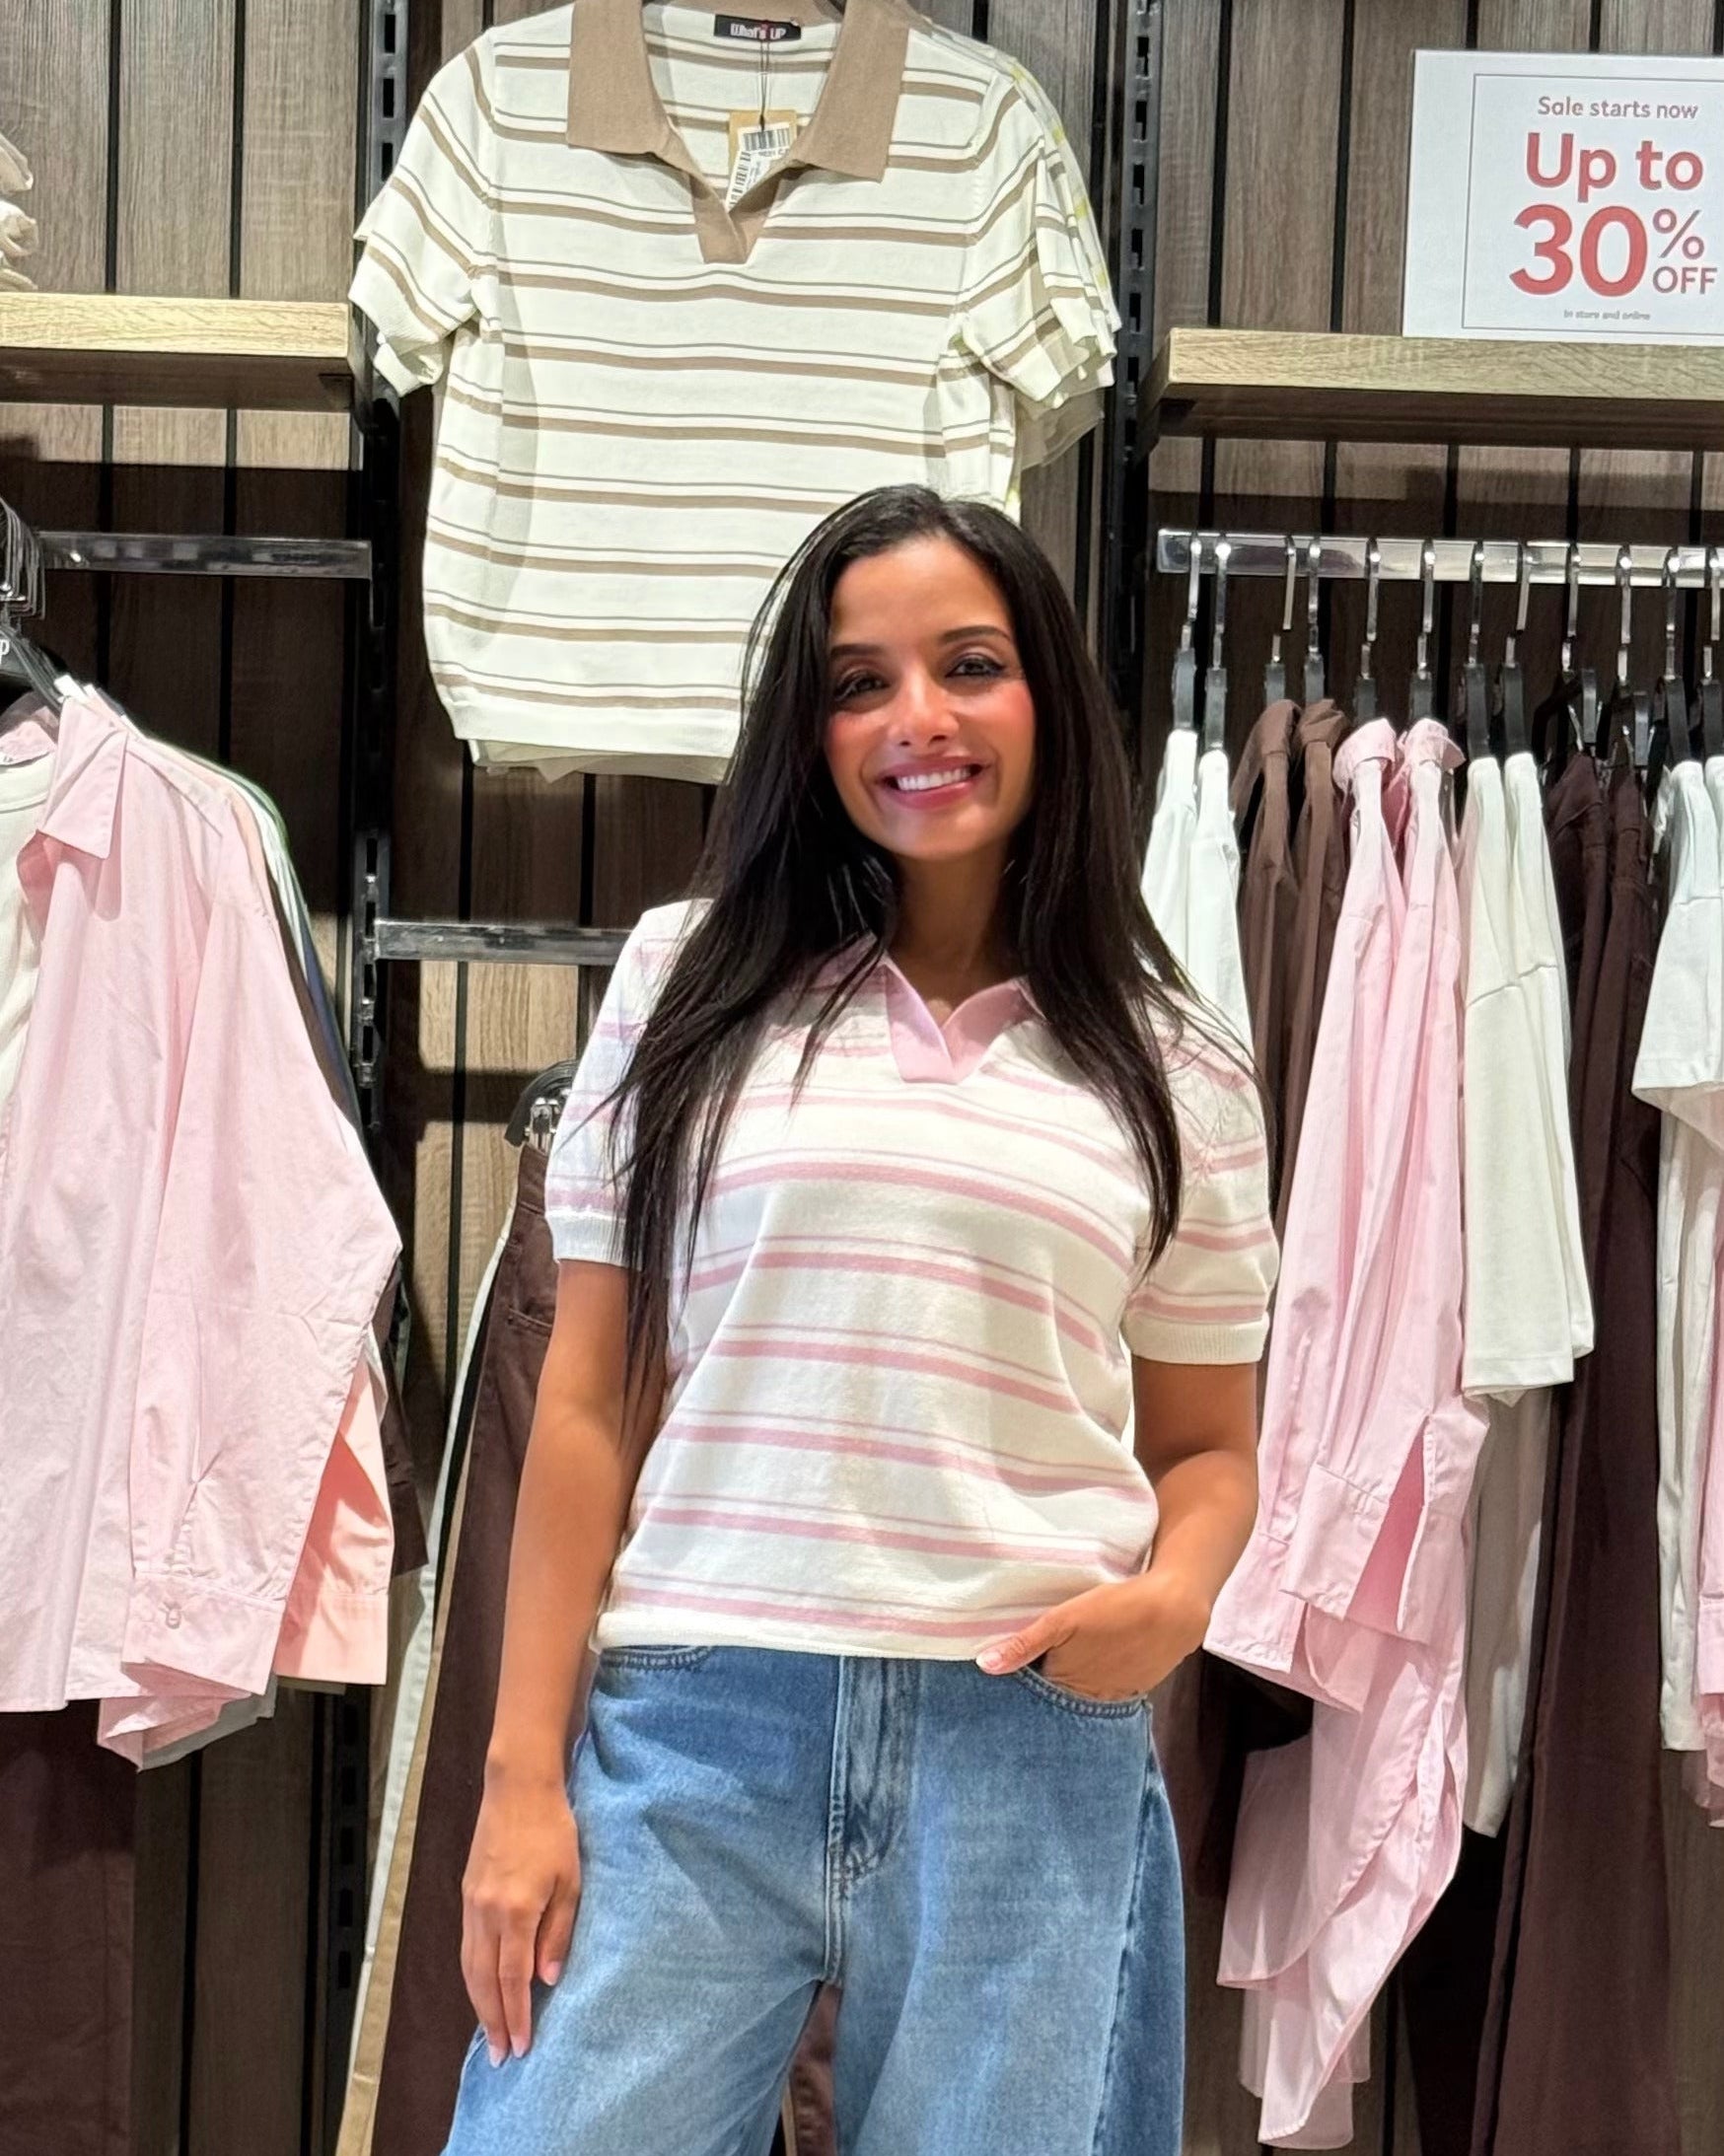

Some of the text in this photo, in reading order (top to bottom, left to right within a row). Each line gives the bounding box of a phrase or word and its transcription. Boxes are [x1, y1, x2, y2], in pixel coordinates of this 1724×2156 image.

[1538, 96, 1699, 119] Sale starts now
[1526, 132, 1704, 203] Up to
[1652, 265, 1718, 295] OFF
